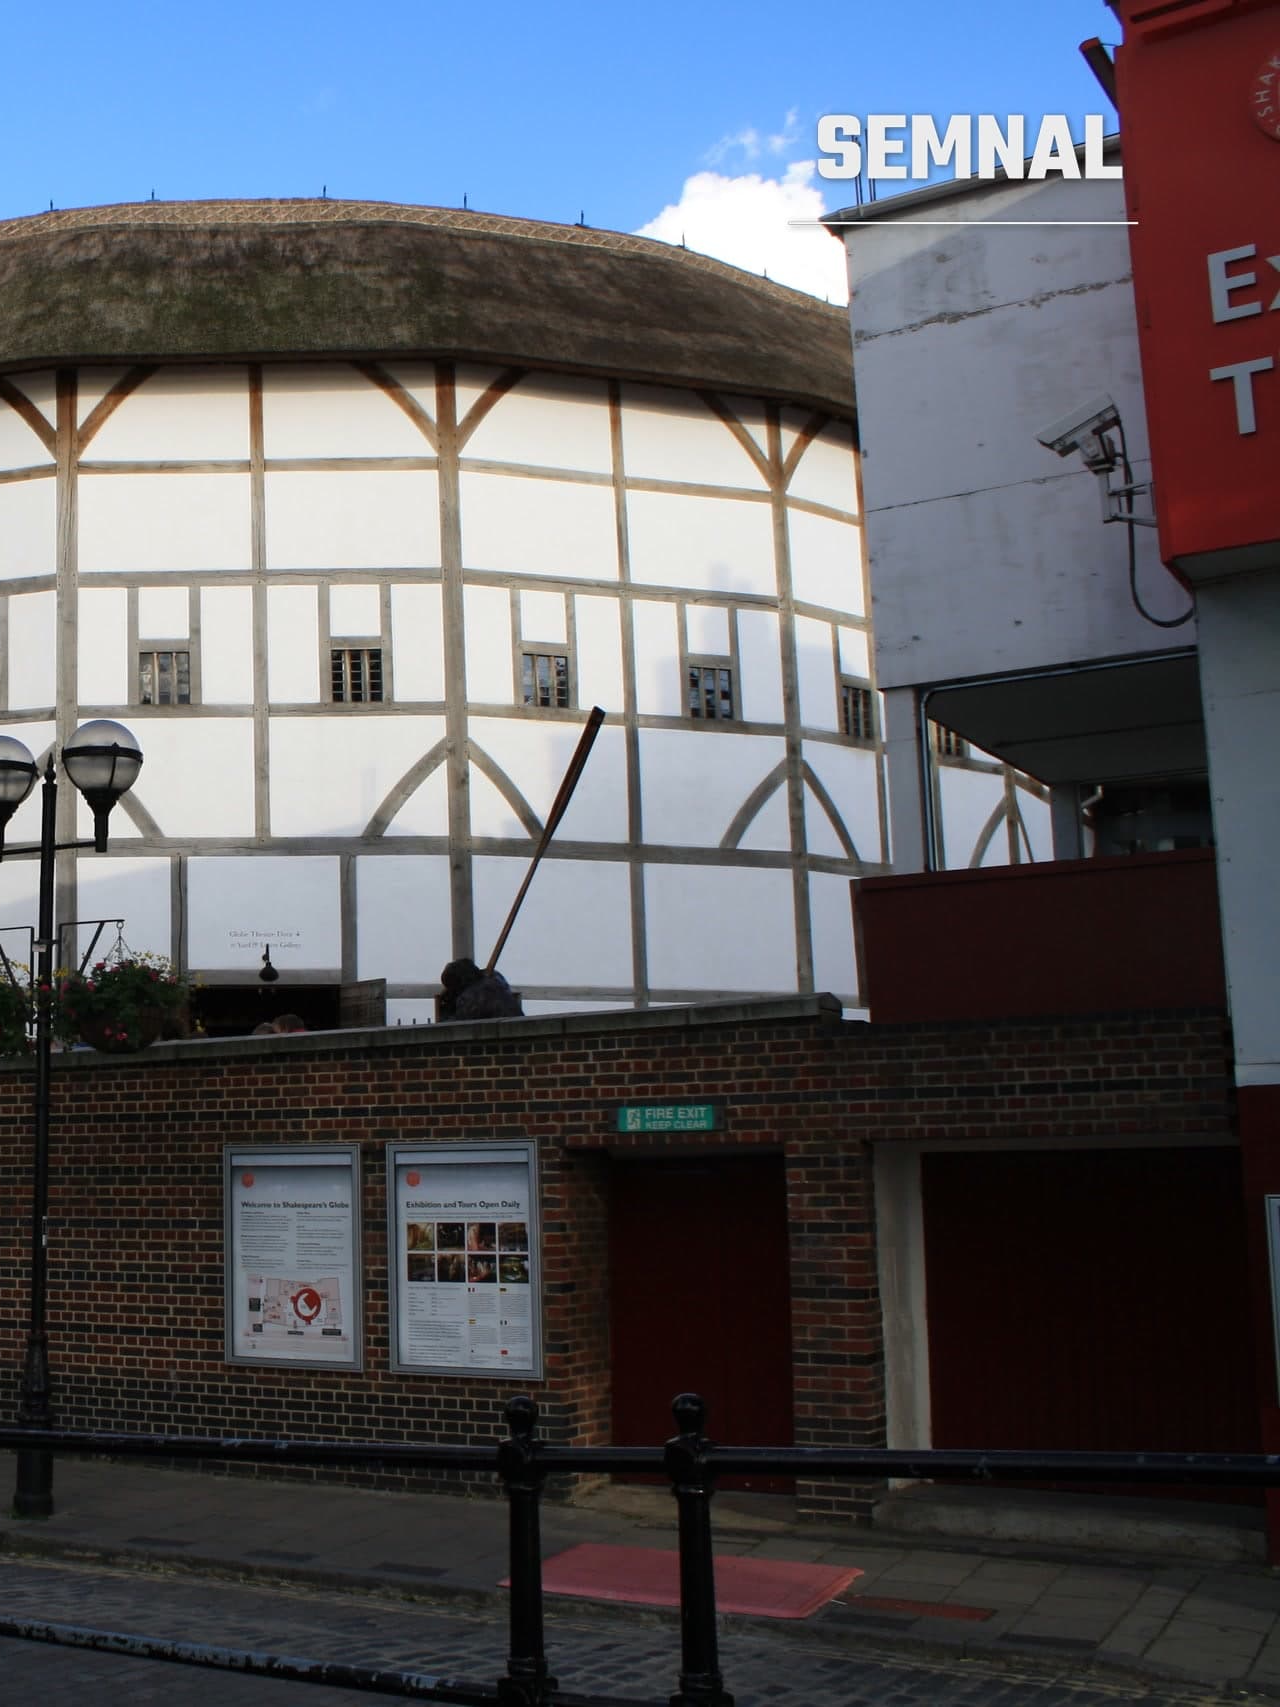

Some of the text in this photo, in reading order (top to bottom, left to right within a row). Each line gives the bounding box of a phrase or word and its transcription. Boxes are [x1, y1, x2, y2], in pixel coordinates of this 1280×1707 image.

[645, 1107, 707, 1119] FIRE EXIT
[645, 1120, 706, 1130] KEEP CLEAR
[241, 1201, 350, 1210] Welcome to Shakespeare's Globe
[478, 1200, 500, 1210] Open
[500, 1200, 521, 1210] Daily
